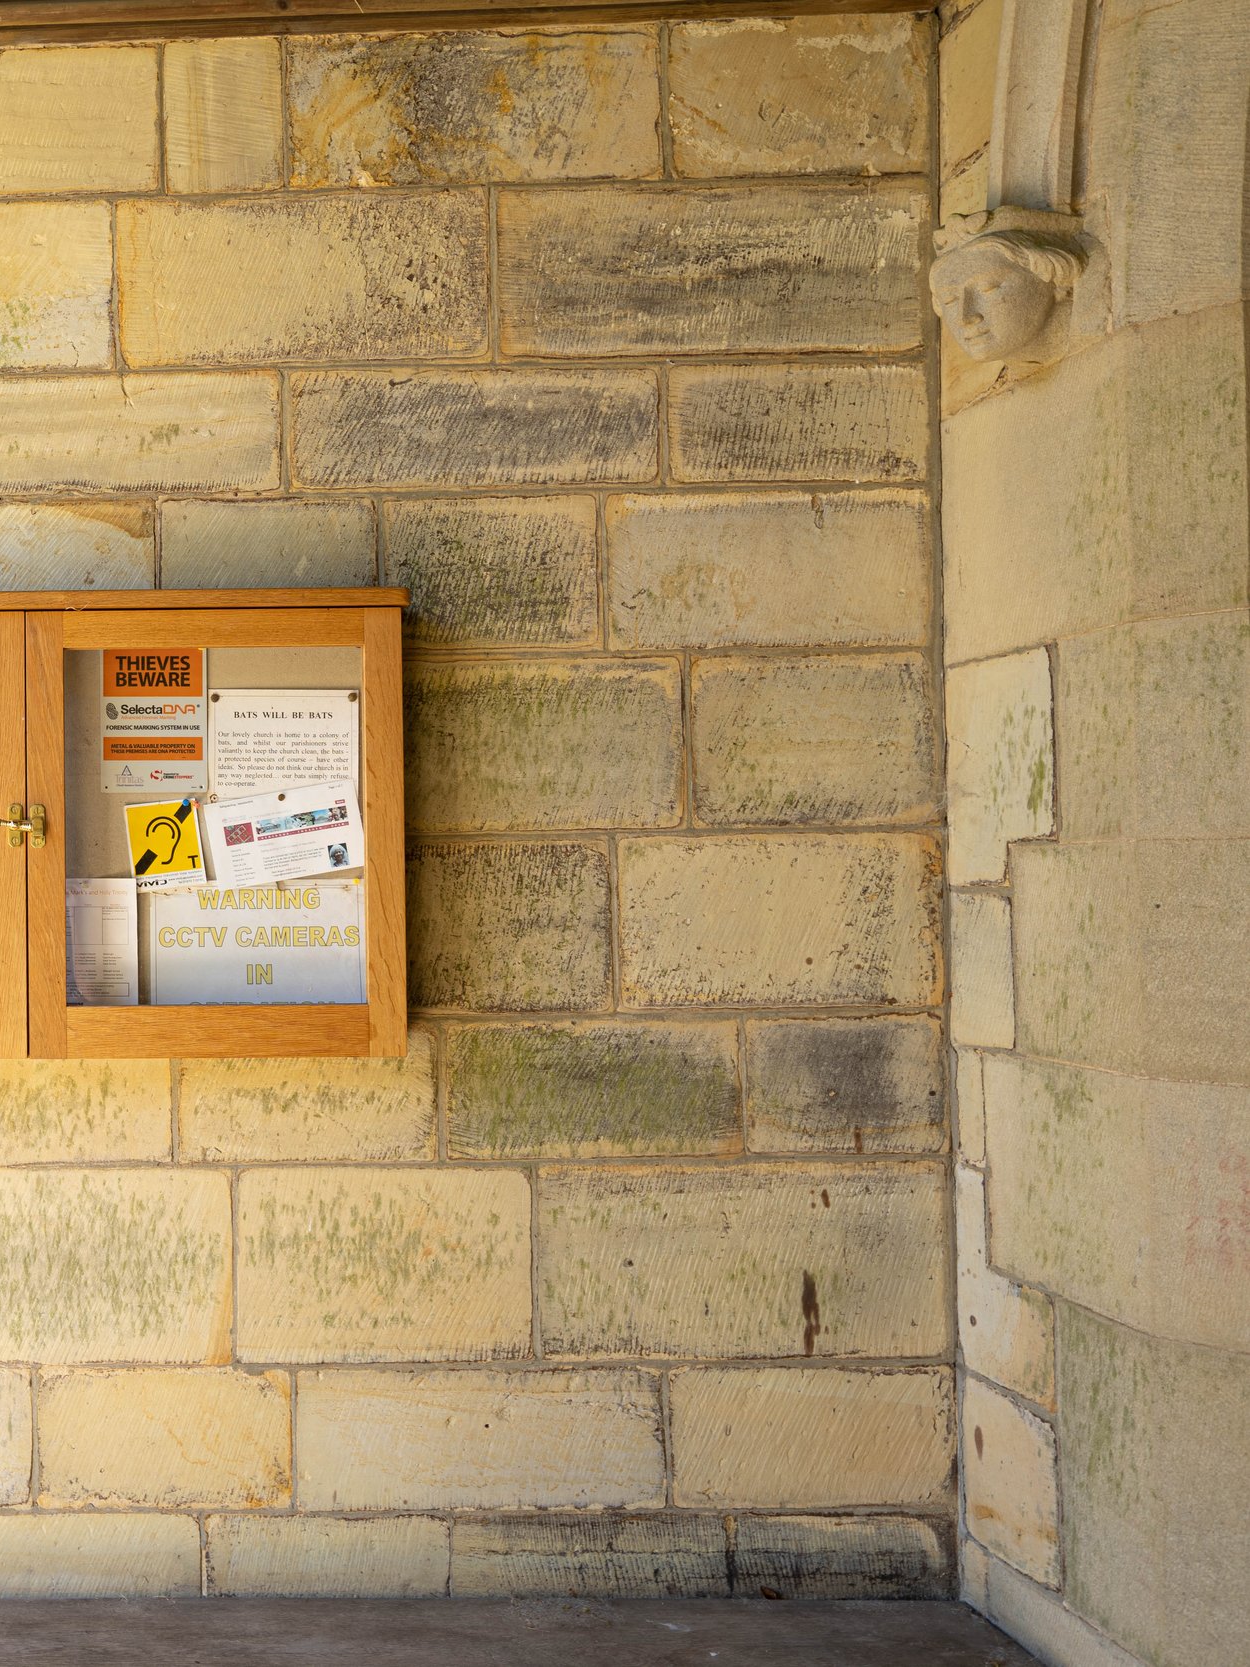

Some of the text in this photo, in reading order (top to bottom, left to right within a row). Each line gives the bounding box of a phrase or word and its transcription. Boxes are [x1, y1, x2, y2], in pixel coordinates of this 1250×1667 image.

[115, 656, 191, 671] THIEVES
[116, 672, 190, 687] BEWARE
[116, 774, 144, 784] Trinitas
[187, 854, 199, 869] T
[196, 888, 321, 910] WARNING
[158, 925, 361, 948] CCTV CAMERAS
[246, 963, 273, 985] IN
